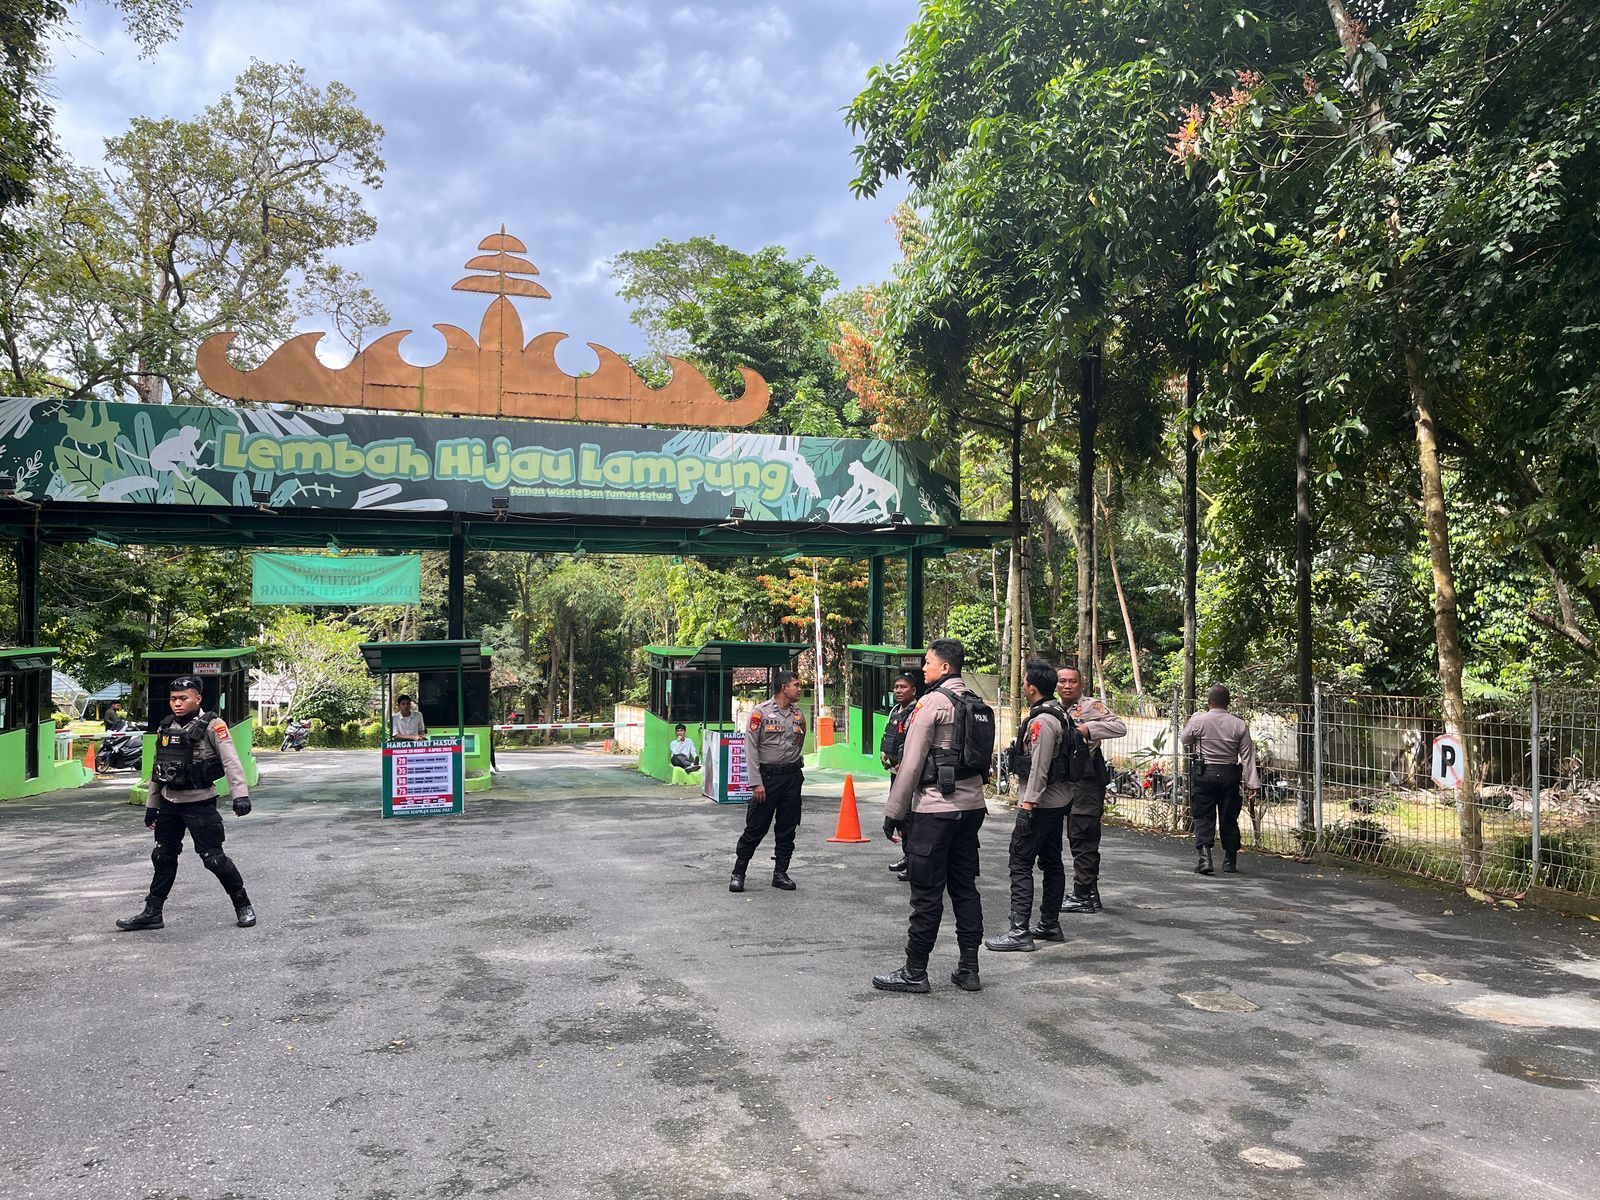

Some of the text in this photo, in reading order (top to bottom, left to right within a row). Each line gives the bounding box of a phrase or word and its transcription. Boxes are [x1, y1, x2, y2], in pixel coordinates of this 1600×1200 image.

[219, 430, 790, 502] Lembah Hijau Lampung
[509, 486, 546, 497] Taman
[605, 489, 639, 500] Taman
[639, 490, 673, 501] Satwa
[433, 739, 458, 747] MASUK
[1441, 744, 1456, 778] P
